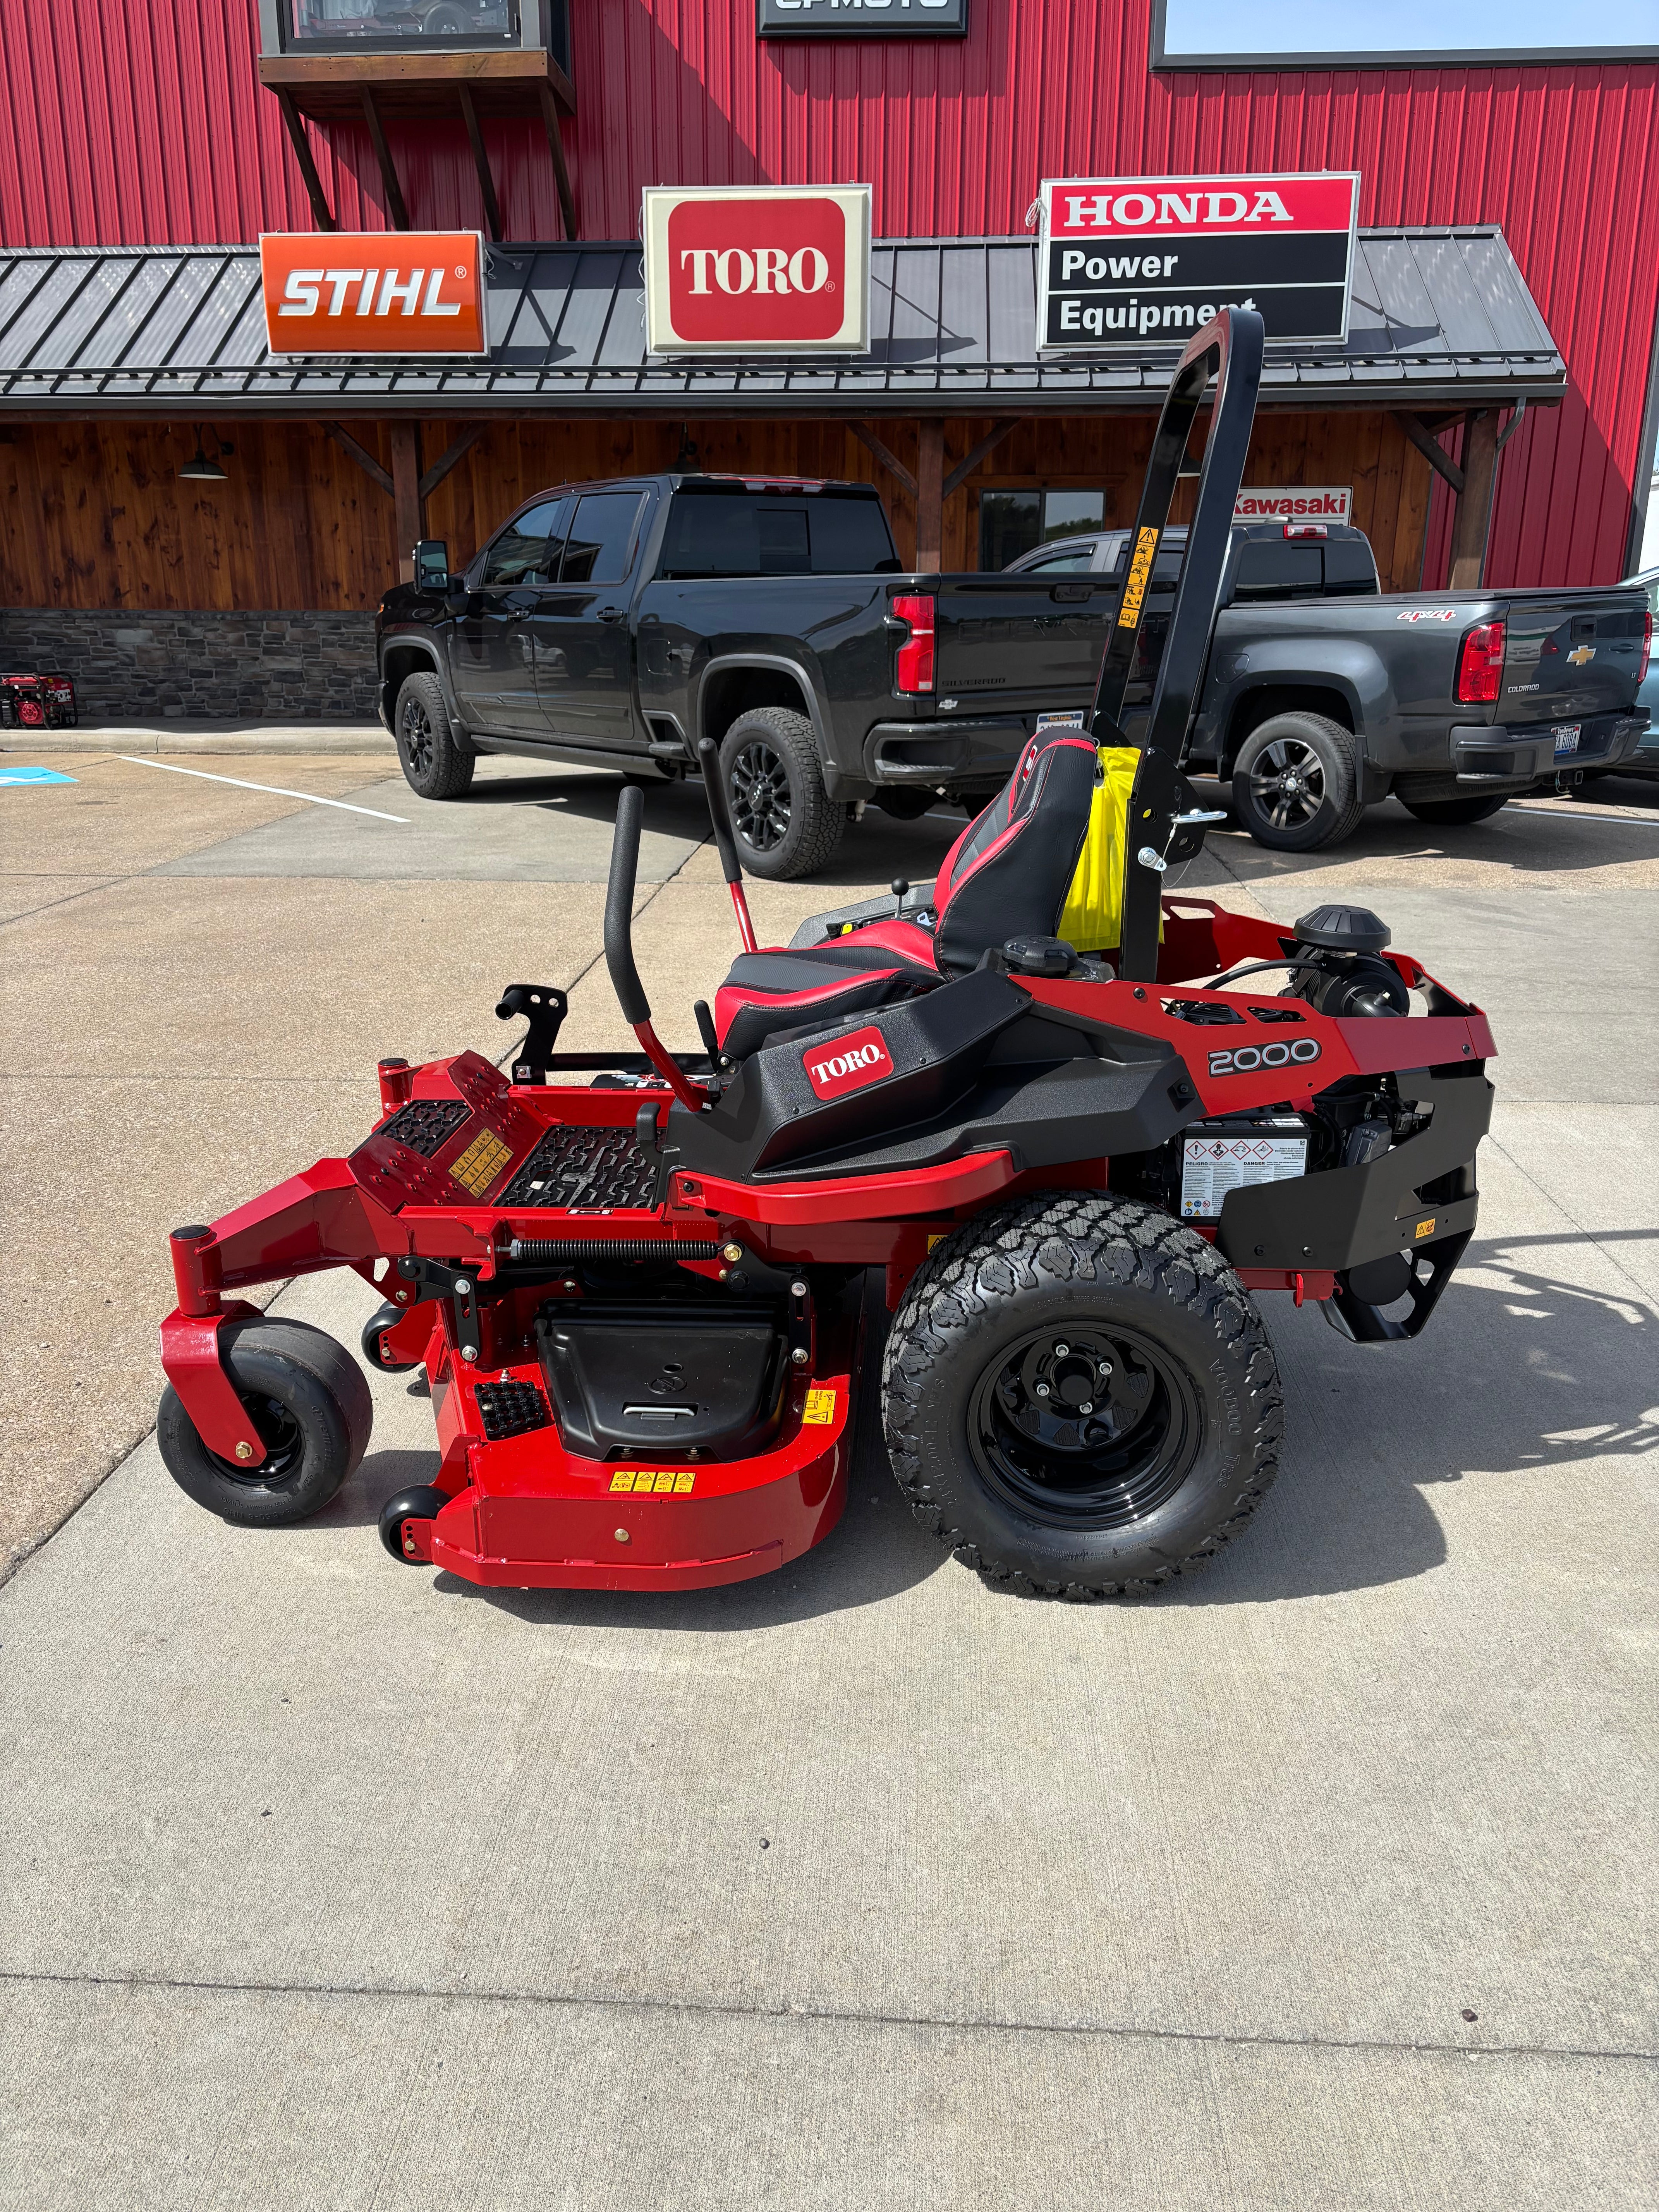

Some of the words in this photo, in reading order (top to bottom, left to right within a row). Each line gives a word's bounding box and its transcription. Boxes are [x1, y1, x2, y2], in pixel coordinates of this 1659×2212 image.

[1064, 192, 1293, 227] HONDA
[1062, 250, 1178, 280] Power
[1060, 297, 1256, 336] Equipmet
[942, 678, 1006, 687] SILVERADO
[1508, 684, 1539, 693] COLORADO
[1562, 733, 1577, 749] 6084
[1209, 1039, 1320, 1075] 2000
[1209, 1358, 1243, 1436] VOODOO
[1217, 1455, 1241, 1489] Trac
